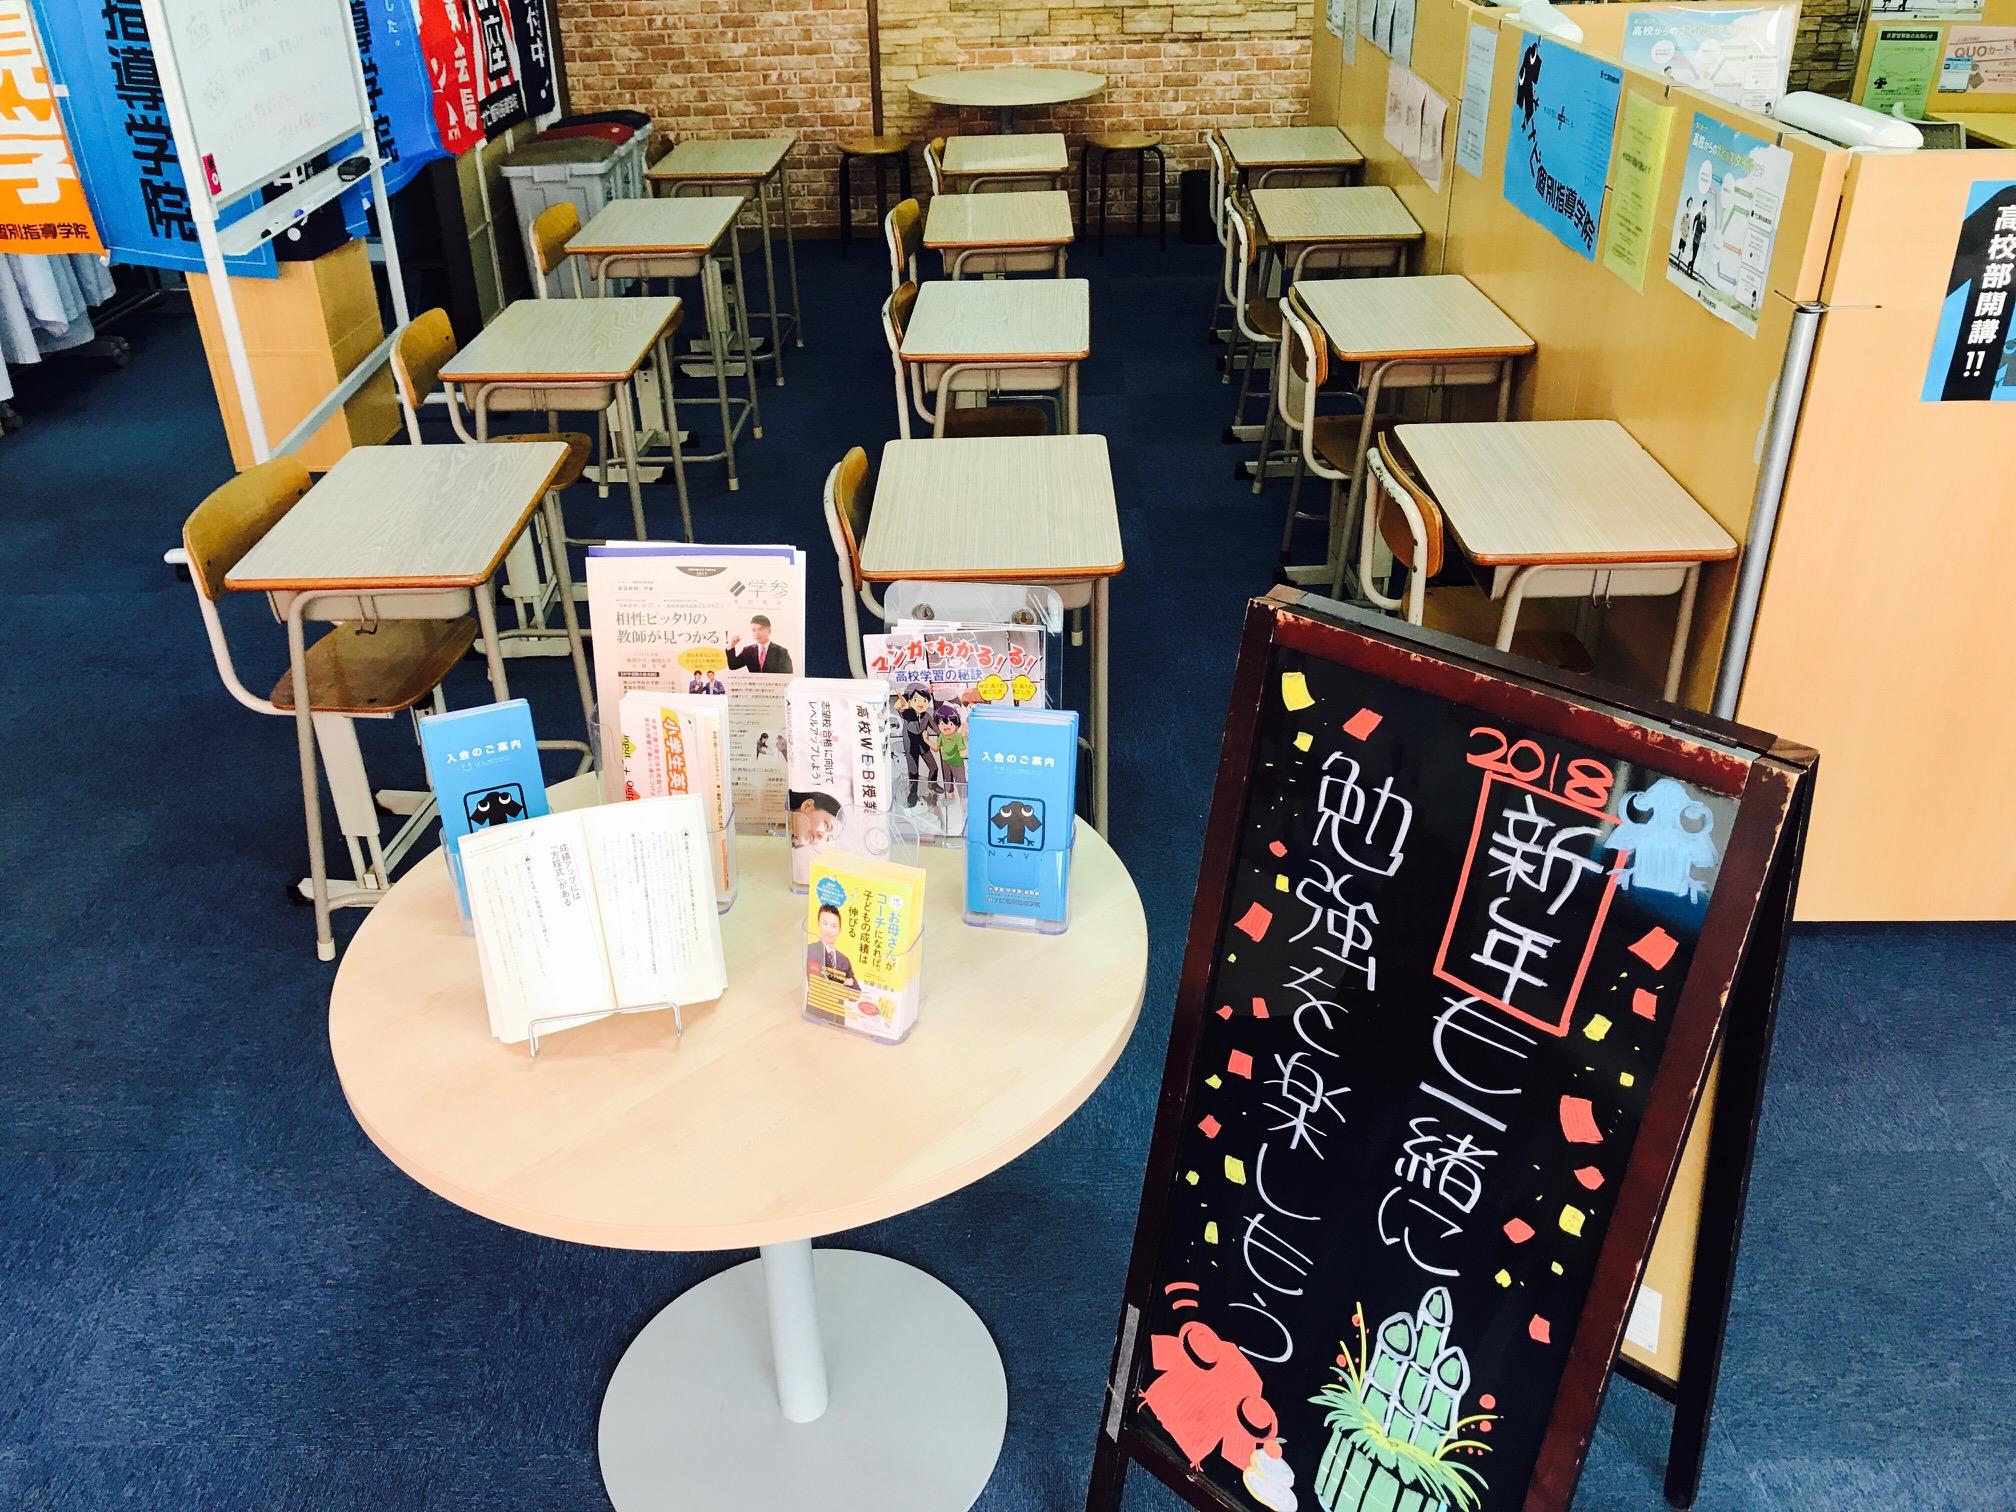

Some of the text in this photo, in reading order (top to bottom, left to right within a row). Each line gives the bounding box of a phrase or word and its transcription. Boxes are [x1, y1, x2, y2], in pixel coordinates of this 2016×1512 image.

[896, 668, 983, 682] 高校学習の秘訣
[446, 739, 521, 764] 入会のご案内
[662, 716, 688, 796] 小学生英
[982, 752, 1055, 767] 入会のご案内
[1466, 727, 1614, 806] 2018
[848, 906, 859, 938] 伸びる
[858, 890, 874, 965] 子どもの成績は
[884, 911, 901, 971] お母さんが
[1229, 750, 1414, 1364] 勉強を楽しもう
[1377, 794, 1604, 1278] 新年も一緒に
